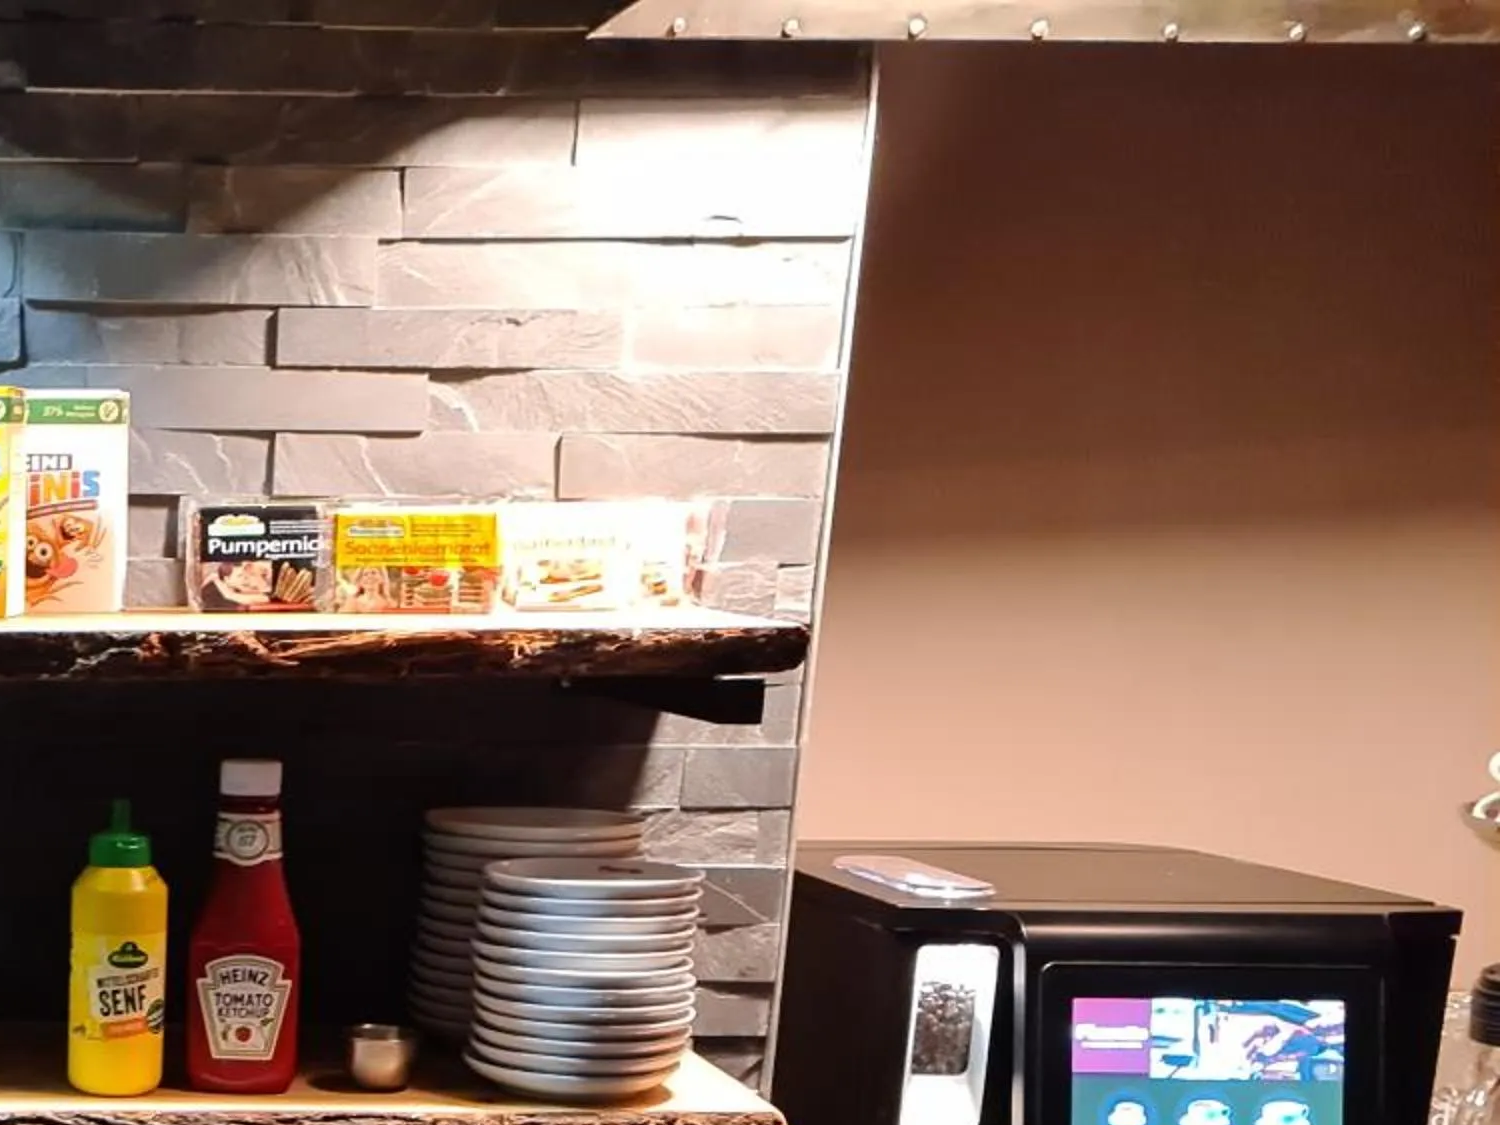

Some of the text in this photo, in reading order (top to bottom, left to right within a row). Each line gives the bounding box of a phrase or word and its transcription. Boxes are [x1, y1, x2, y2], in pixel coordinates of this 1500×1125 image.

[26, 470, 100, 507] iNiS
[207, 536, 324, 558] Pumpernic
[219, 968, 269, 986] HEINZ
[98, 983, 147, 1017] SENF
[215, 991, 274, 1007] TOMATO
